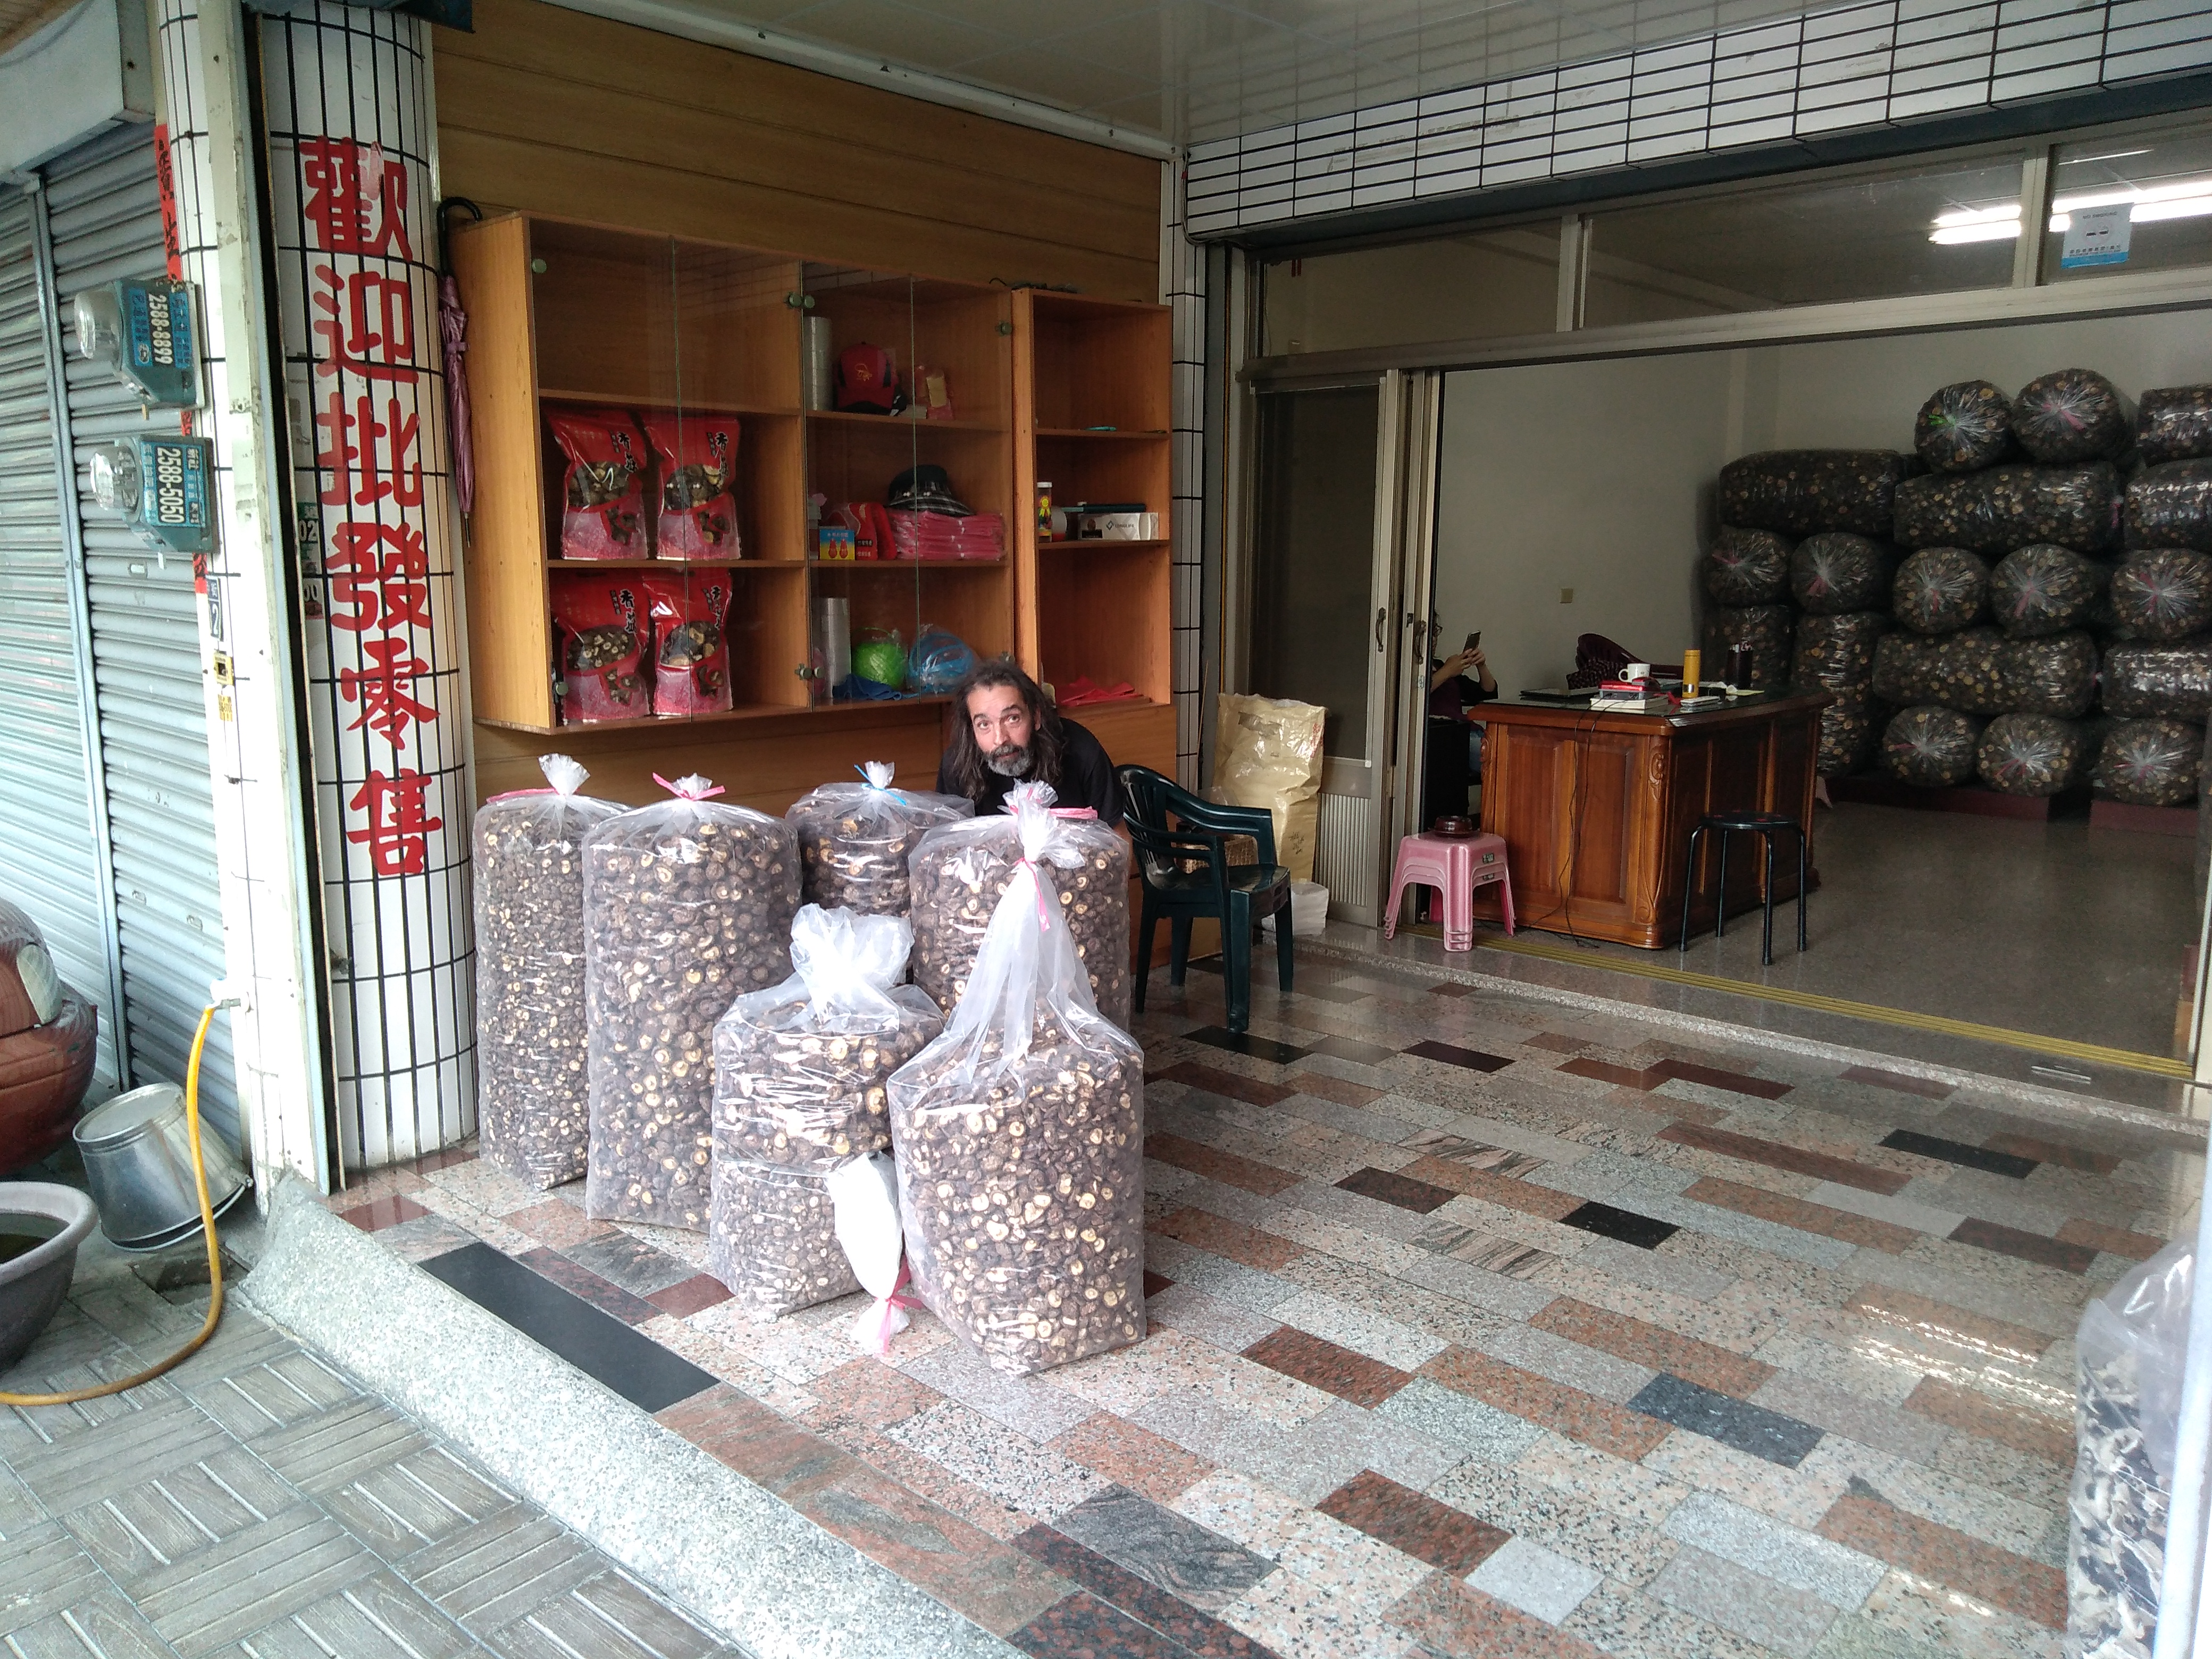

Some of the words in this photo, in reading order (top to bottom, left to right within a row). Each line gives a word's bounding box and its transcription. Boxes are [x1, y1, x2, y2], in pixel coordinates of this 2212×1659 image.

[148, 293, 173, 365] 2588-8899
[157, 447, 185, 523] 2588-5050
[299, 136, 441, 876] 歡迎批發零售
[298, 521, 318, 542] 02
